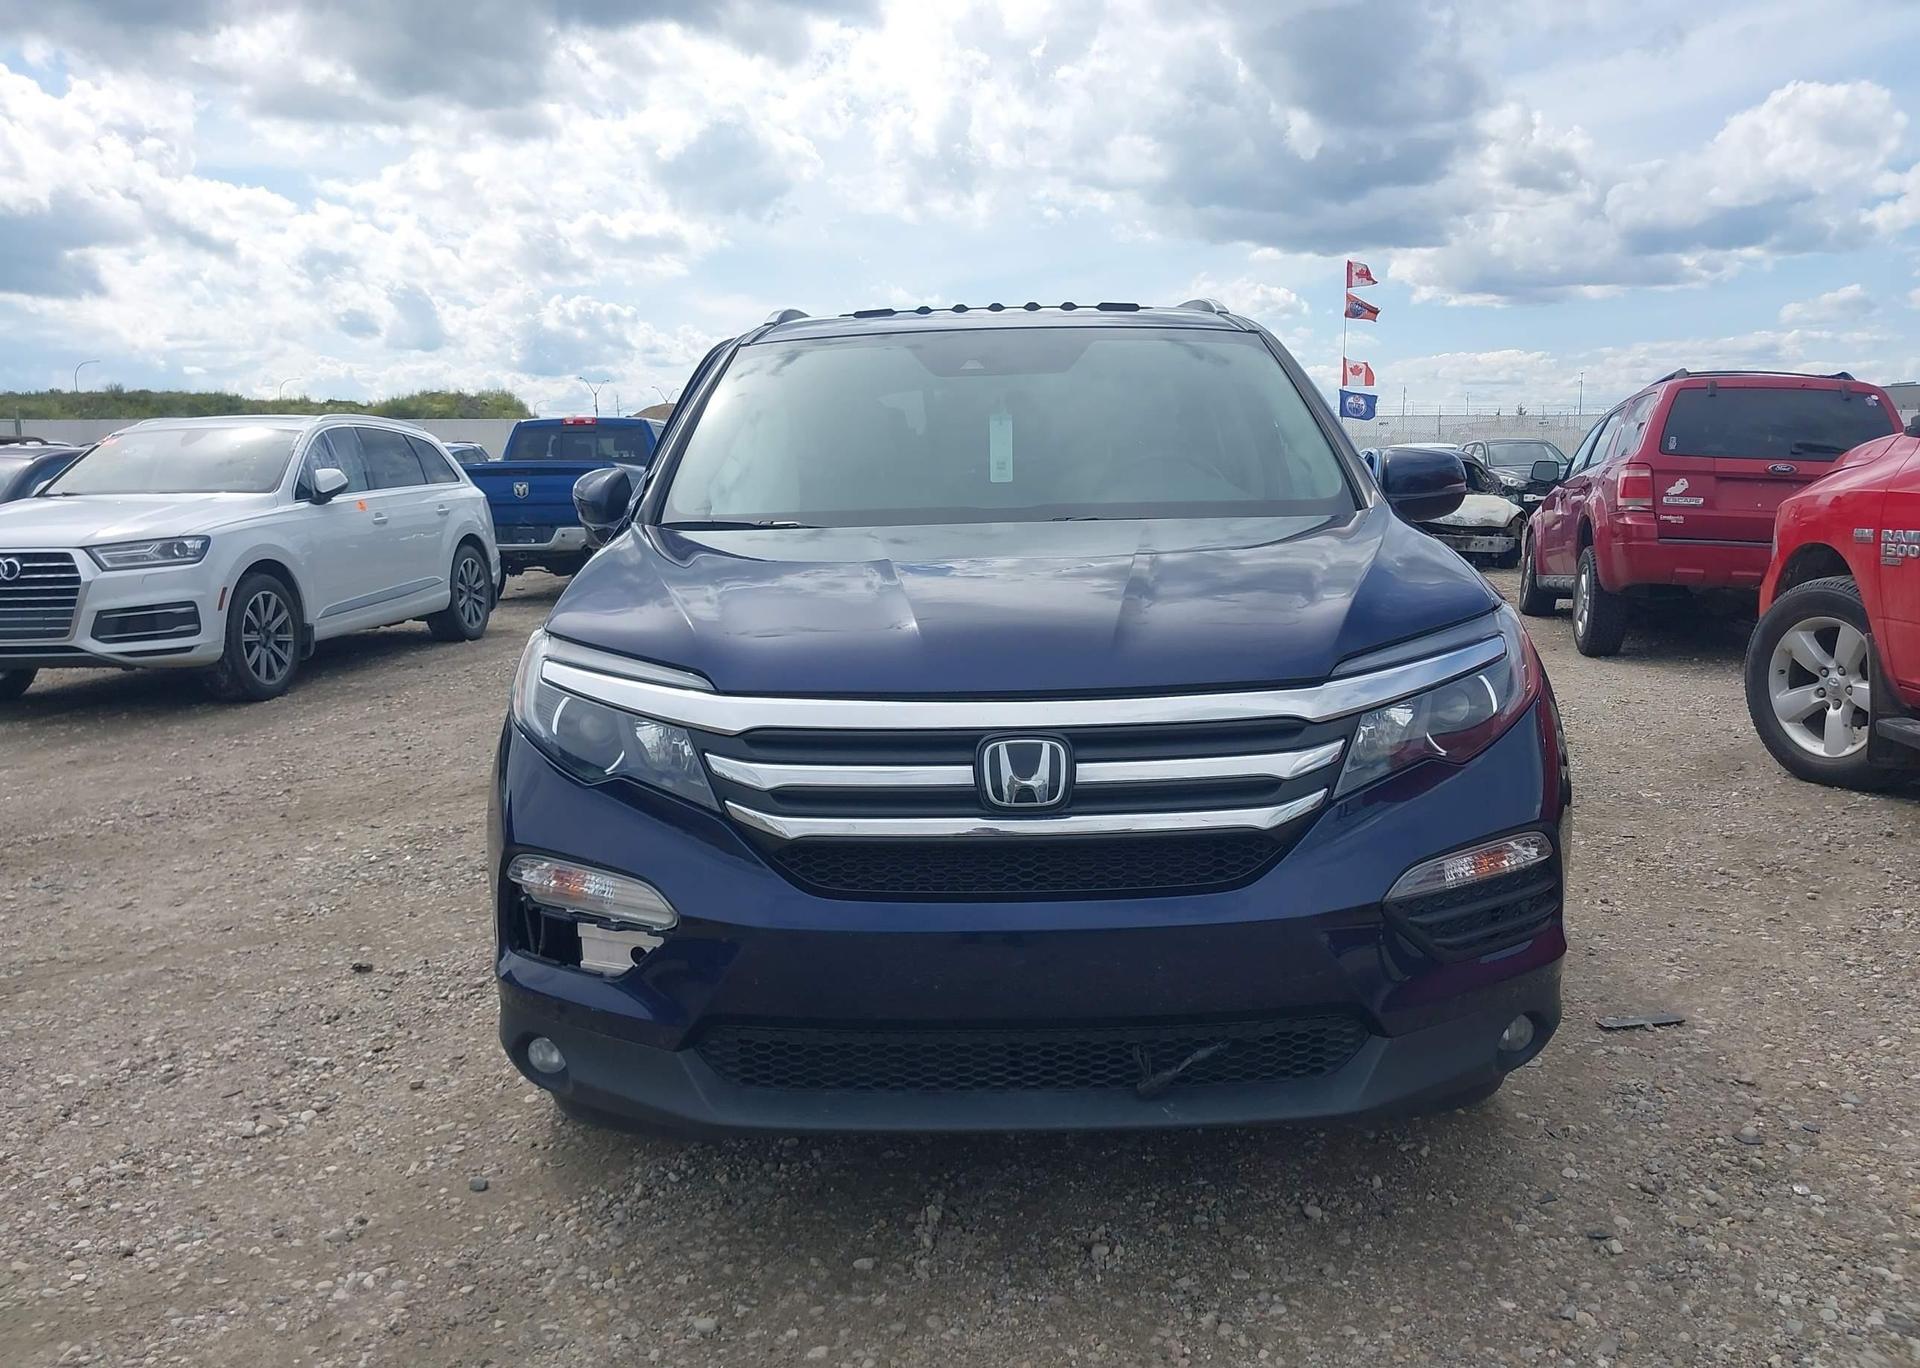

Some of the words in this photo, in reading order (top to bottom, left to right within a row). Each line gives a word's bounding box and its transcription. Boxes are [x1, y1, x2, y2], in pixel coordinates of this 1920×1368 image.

[1665, 497, 1701, 505] ESCAPE
[1881, 529, 1920, 543] RAM
[1881, 543, 1920, 557] 1500
